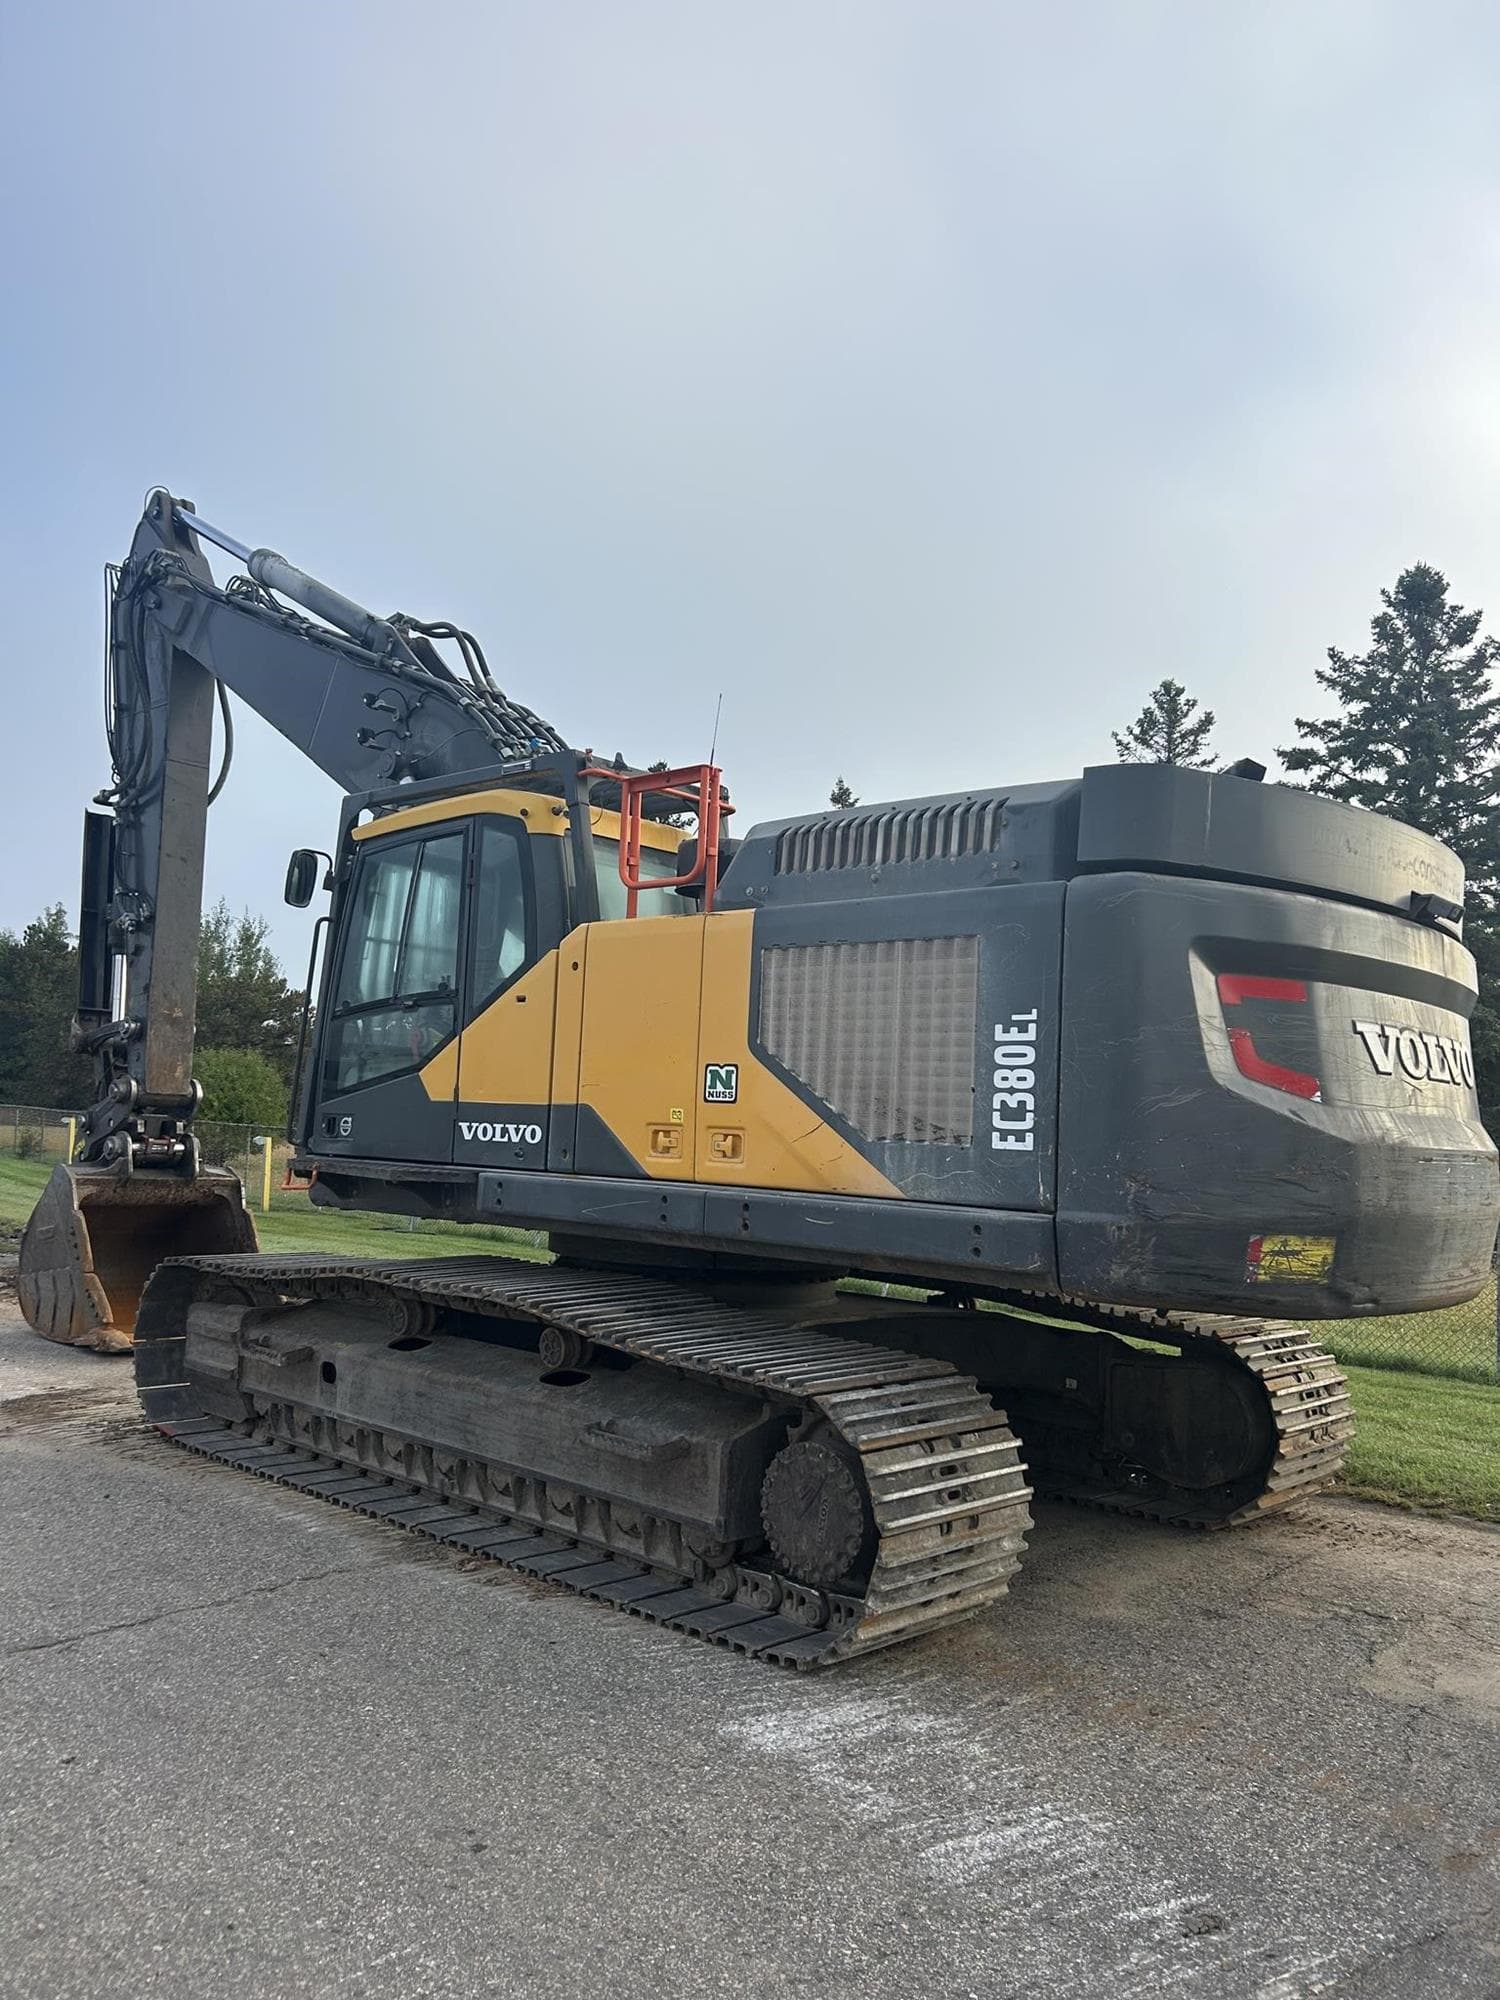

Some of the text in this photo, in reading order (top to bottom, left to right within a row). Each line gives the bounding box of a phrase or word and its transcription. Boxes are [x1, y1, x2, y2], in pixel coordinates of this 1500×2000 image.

[1352, 1019, 1474, 1090] VOLVO
[708, 1069, 735, 1090] N
[991, 1008, 1039, 1151] EC380EL
[707, 1090, 735, 1100] NUSS
[458, 1121, 542, 1144] VOLVO
